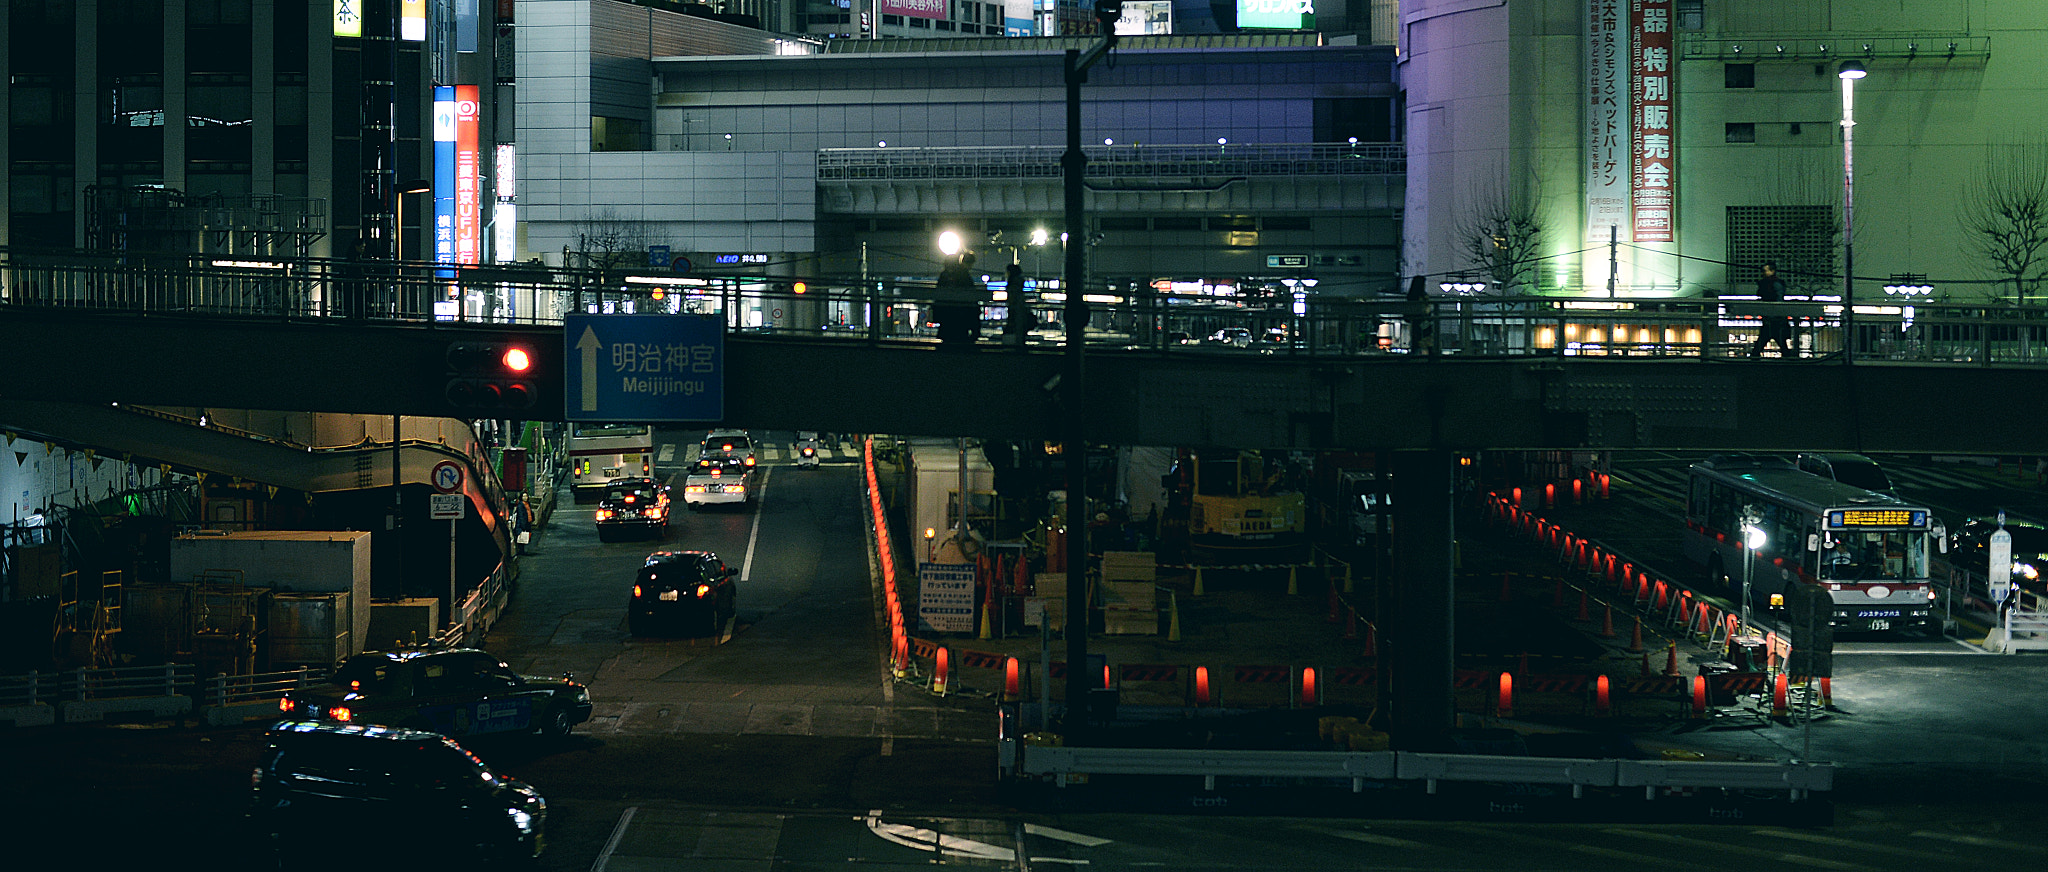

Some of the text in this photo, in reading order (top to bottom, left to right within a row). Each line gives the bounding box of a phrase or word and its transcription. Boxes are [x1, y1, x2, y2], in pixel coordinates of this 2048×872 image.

[1643, 0, 1668, 33] 器
[1603, 0, 1617, 187] 大市&〈シモンズ〉ベッドバーゲン
[1643, 47, 1670, 188] 特別販売会
[459, 150, 474, 264] 三菱東京UFJ銀行
[437, 214, 451, 266] 横浜銀行
[612, 342, 715, 373] 明治神宮
[623, 377, 705, 396] Meijijingu
[1858, 610, 1901, 618] ノンステップバス
